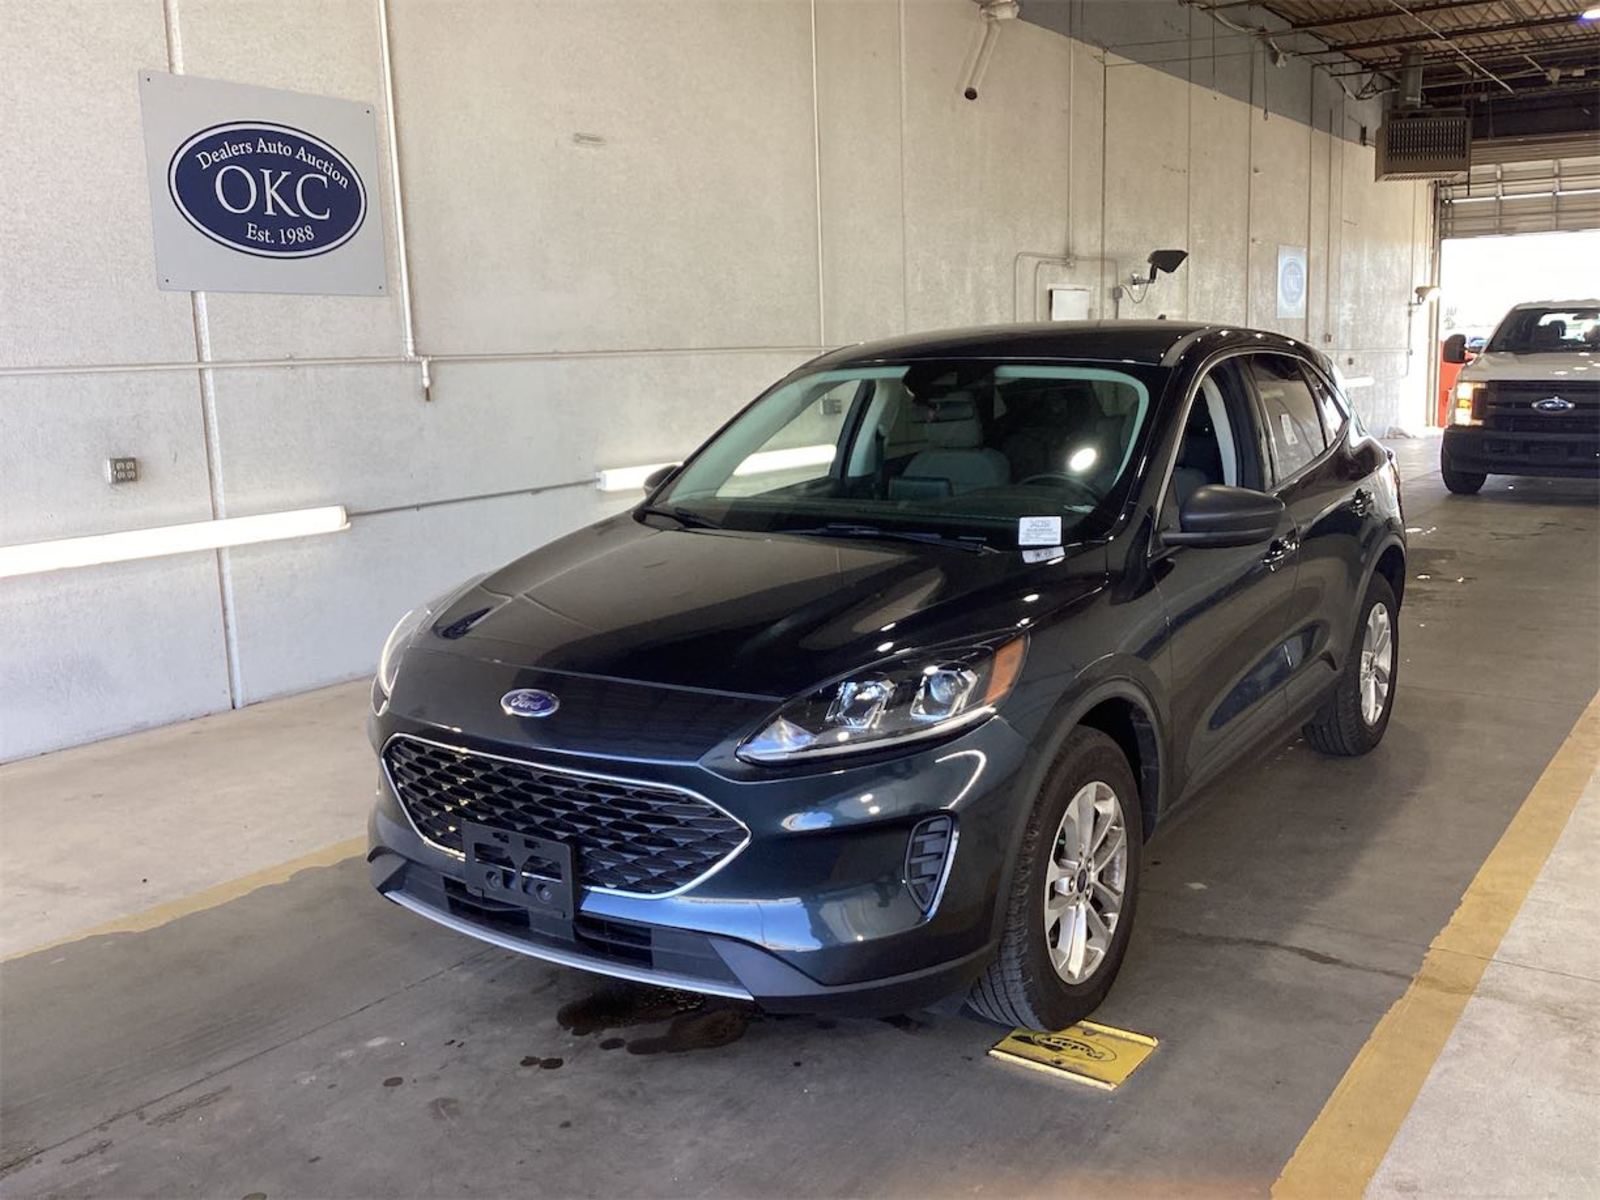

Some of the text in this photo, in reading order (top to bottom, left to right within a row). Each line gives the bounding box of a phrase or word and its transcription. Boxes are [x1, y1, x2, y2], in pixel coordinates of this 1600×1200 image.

[196, 137, 349, 189] Dealers Auto Auction
[215, 165, 331, 220] OKC
[247, 222, 315, 245] Est. 1988
[509, 692, 544, 710] Ford
